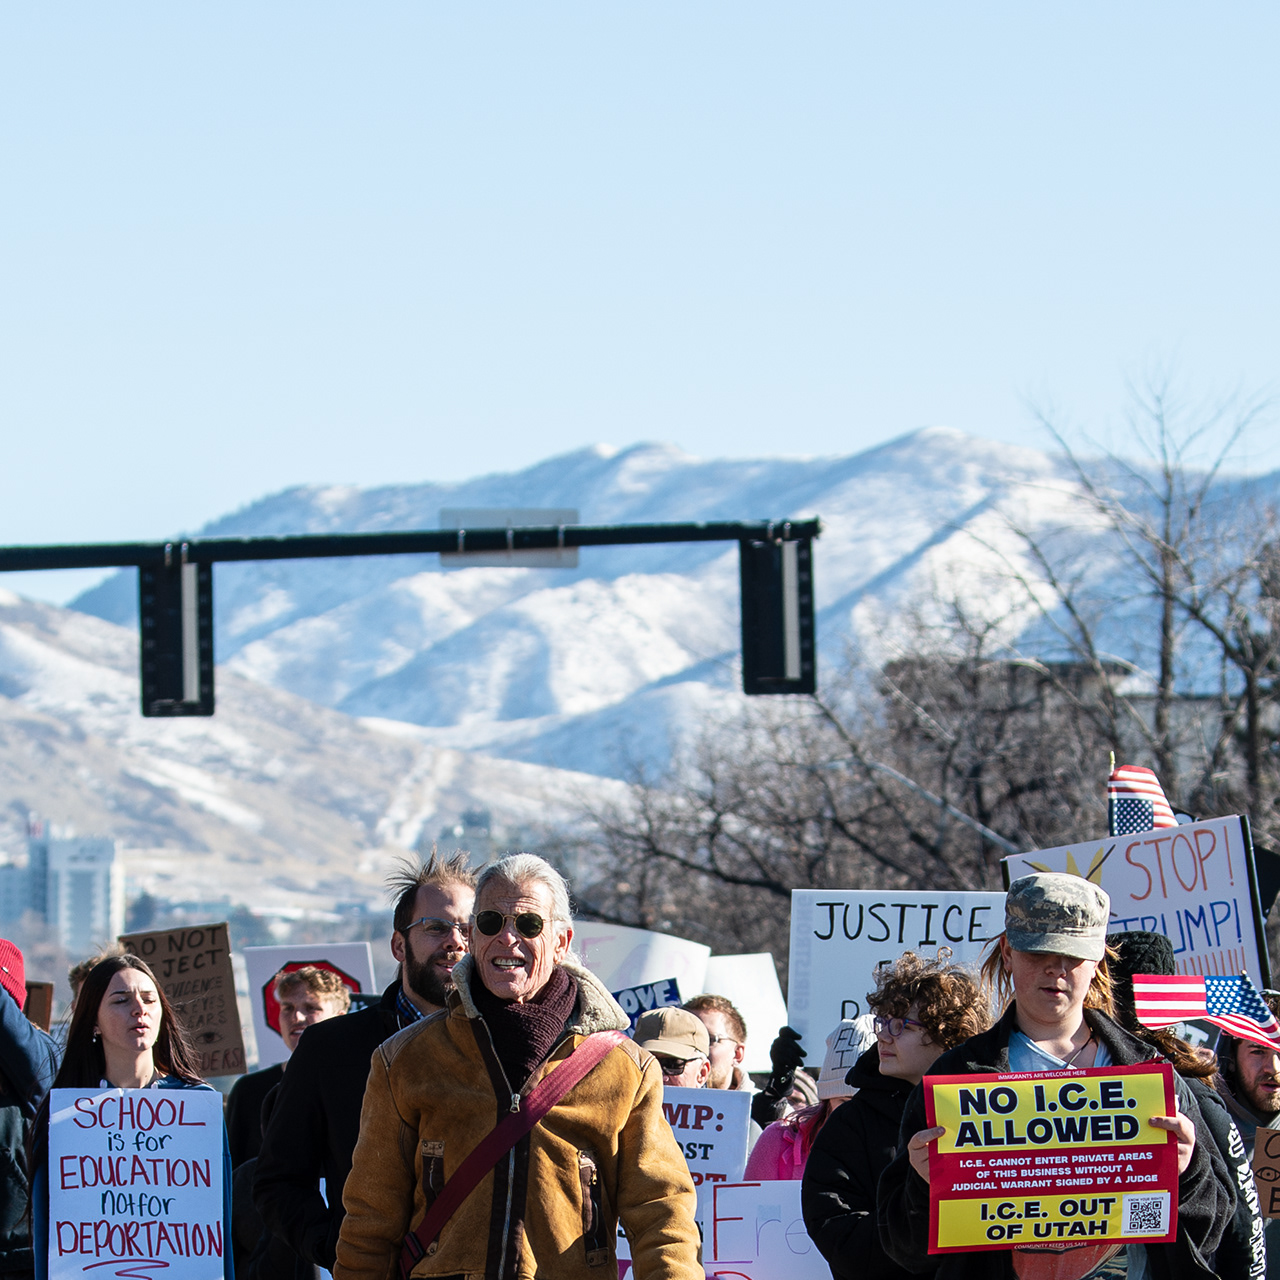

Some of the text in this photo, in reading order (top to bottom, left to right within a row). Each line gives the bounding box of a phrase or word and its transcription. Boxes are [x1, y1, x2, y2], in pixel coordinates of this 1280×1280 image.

[1124, 825, 1235, 901] STOP!
[169, 925, 223, 953] NOT
[813, 902, 992, 948] JUSTICE
[618, 978, 671, 1015] OVE
[72, 1096, 207, 1132] SCHOOL
[958, 1080, 1138, 1116] NO I.C.E.
[106, 1131, 173, 1152] is for
[954, 1114, 1140, 1148] ALLOWED
[59, 1154, 212, 1190] EDUCATION
[959, 1151, 1153, 1168] I.C.E. CANNOT ENTER PRIVATE AREAS
[976, 1164, 1134, 1179] OF THIS BUSINESS WITHOUT A
[951, 1174, 1159, 1192] JUDICIAL WARRANT SIGNED BY A JUDGE
[980, 1197, 1117, 1222] I.C.E. OUT
[56, 1220, 223, 1258] DEPORTATION
[985, 1219, 1109, 1241] OF UTAH
